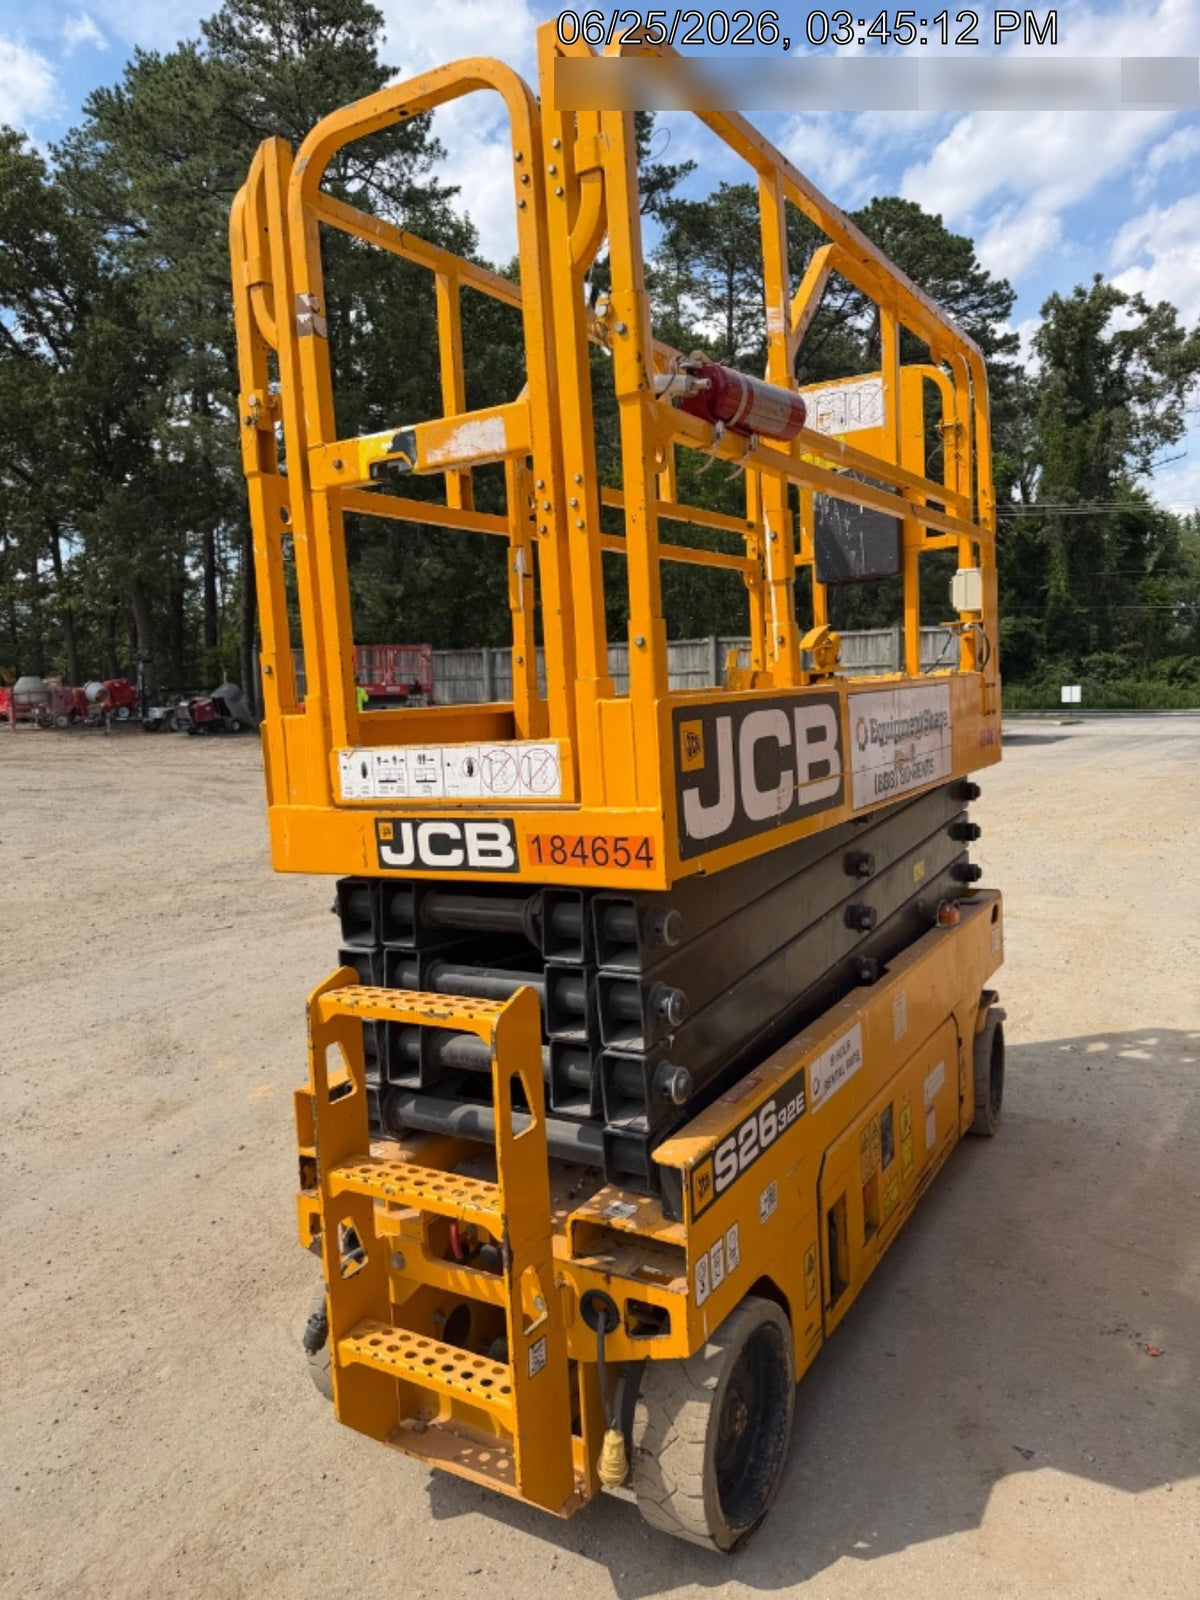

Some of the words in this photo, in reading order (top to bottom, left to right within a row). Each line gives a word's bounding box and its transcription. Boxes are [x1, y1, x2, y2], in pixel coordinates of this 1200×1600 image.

[682, 703, 841, 840] JCB
[380, 822, 515, 868] JCB
[530, 834, 654, 868] 184654
